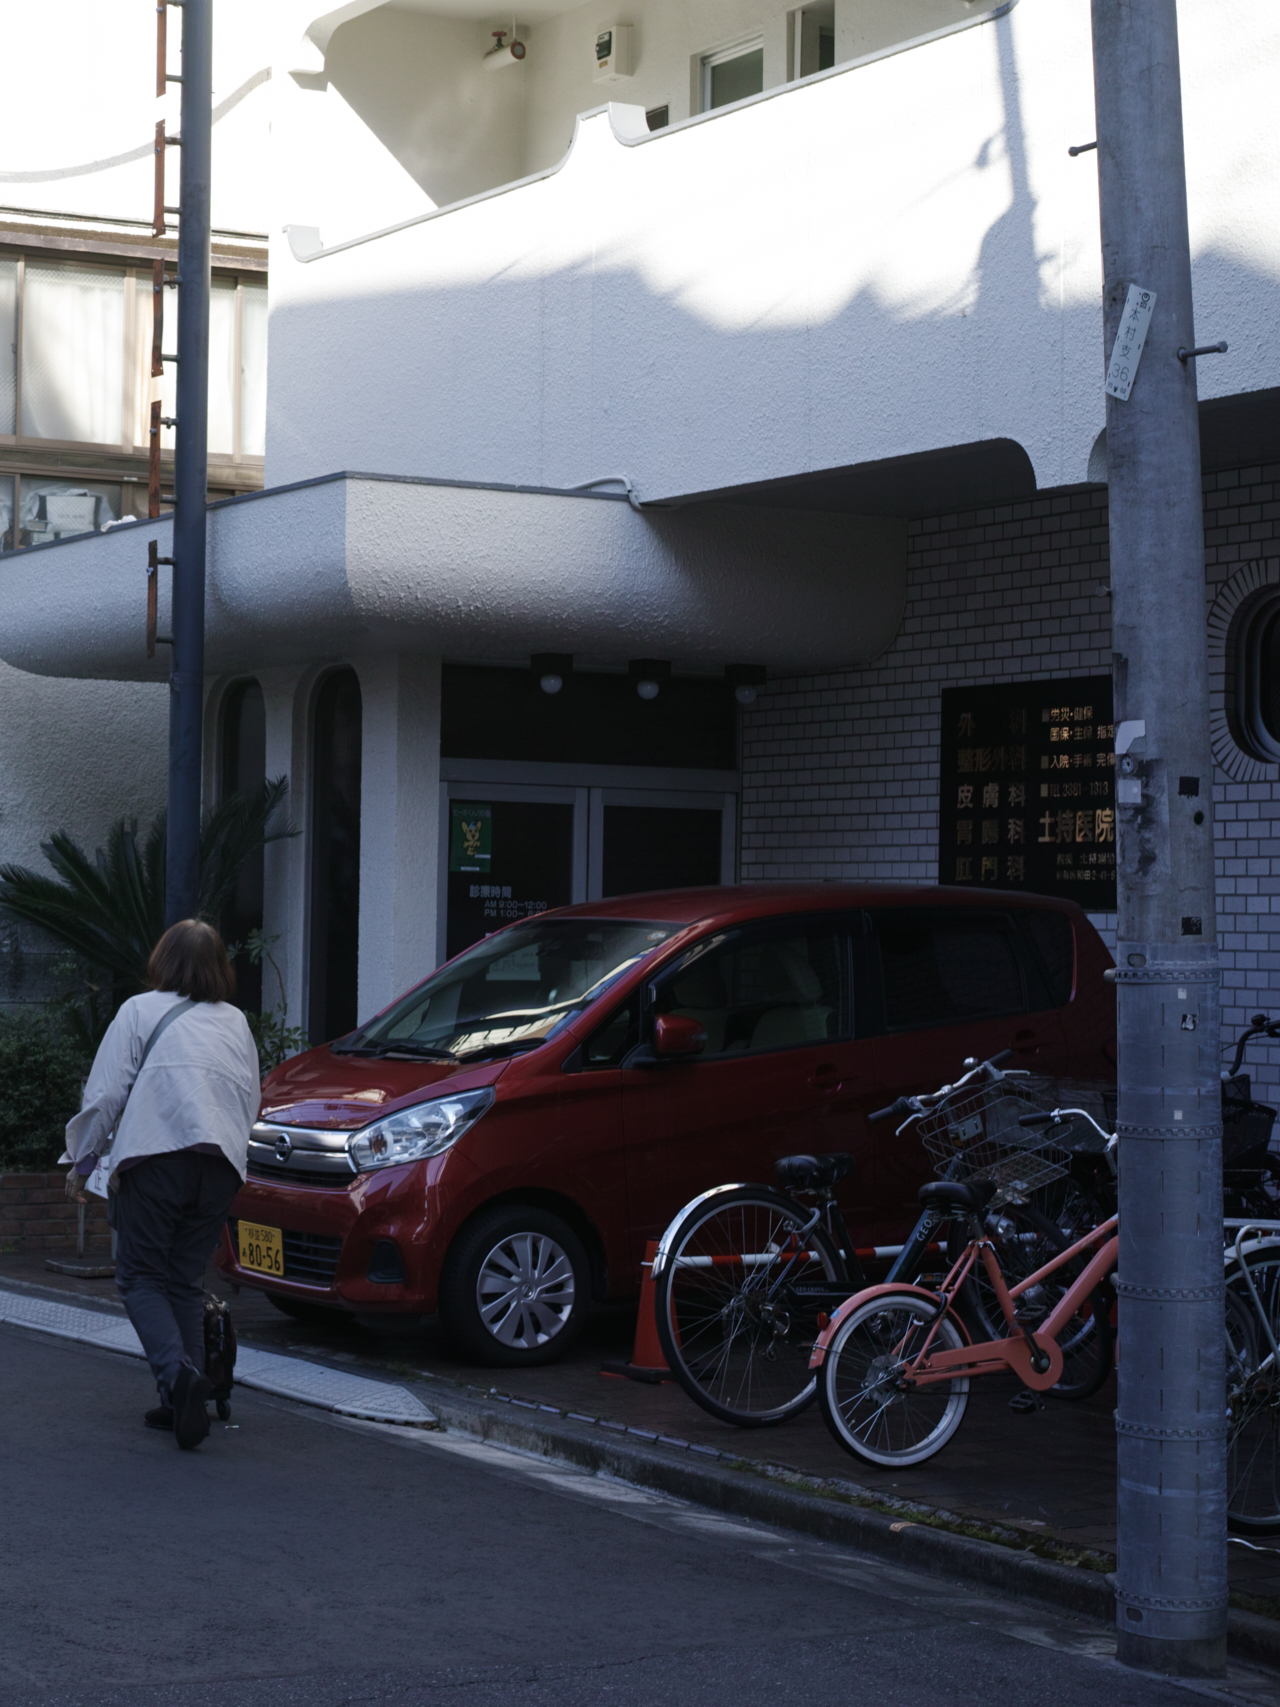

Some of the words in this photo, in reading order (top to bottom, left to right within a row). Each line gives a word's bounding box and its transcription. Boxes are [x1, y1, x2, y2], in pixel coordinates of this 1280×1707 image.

[957, 744, 1028, 773] 整形外科
[956, 781, 1027, 809] 皮膚科
[956, 818, 1026, 845] 胃腸科
[1038, 807, 1115, 843] 土持医院
[955, 855, 1026, 882] 肛門科
[469, 884, 512, 899] 診療時間
[484, 900, 497, 908] AM
[484, 908, 497, 917] PM
[248, 1242, 281, 1272] 80-56
